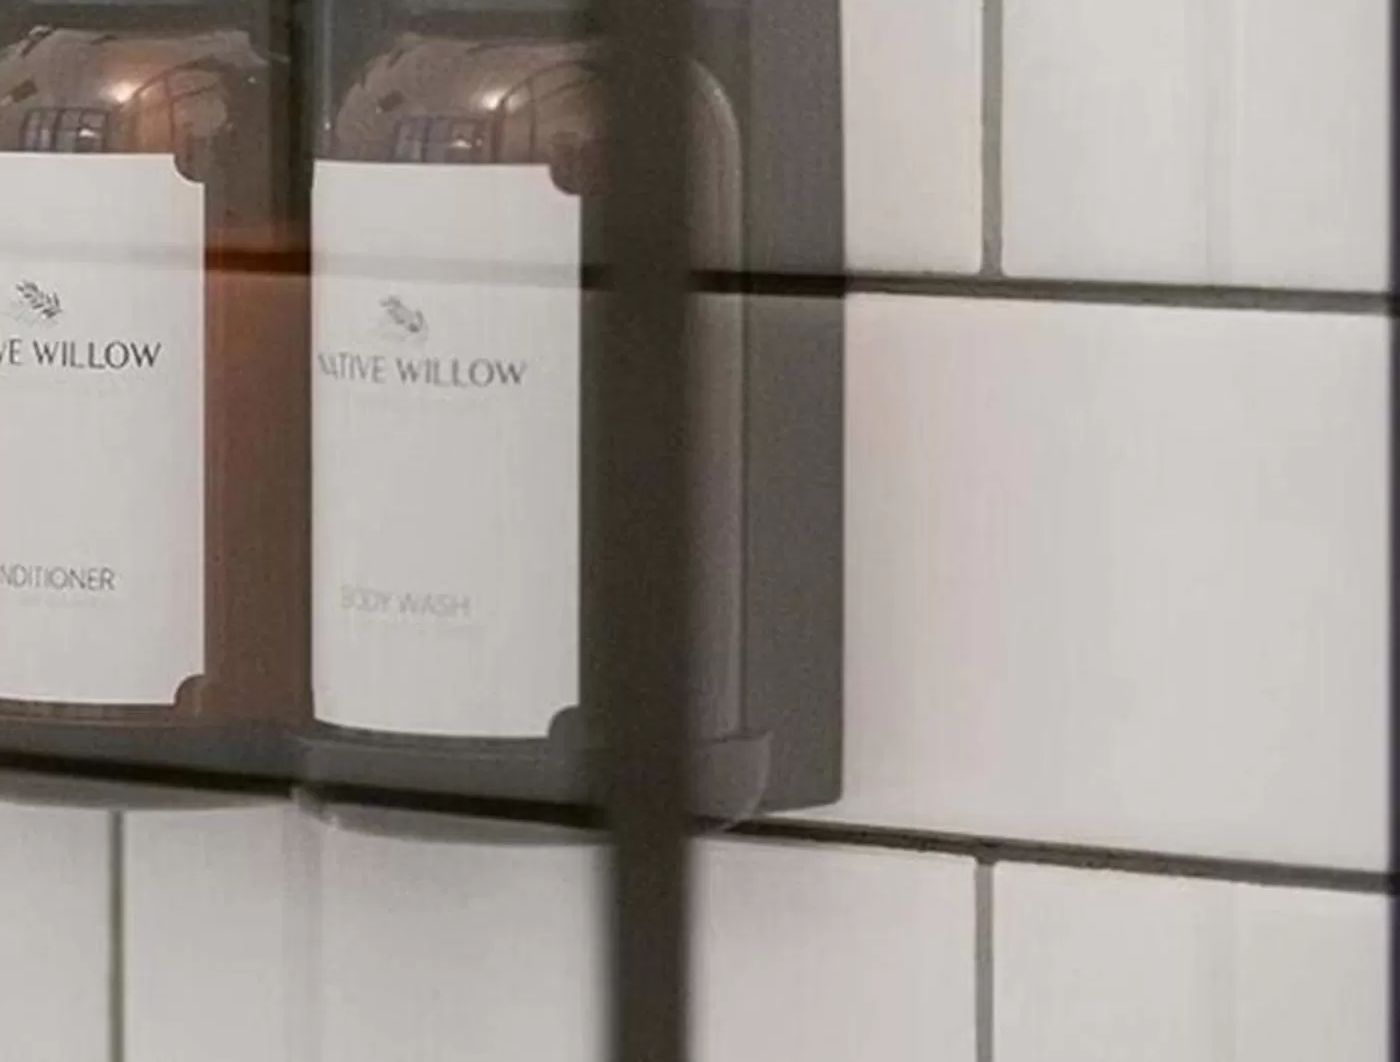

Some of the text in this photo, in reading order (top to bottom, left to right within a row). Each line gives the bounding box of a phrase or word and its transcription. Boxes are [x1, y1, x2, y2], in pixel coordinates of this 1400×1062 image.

[31, 338, 163, 371] WILLOW
[395, 356, 528, 388] WILLOW
[340, 584, 472, 619] BODY WASH
